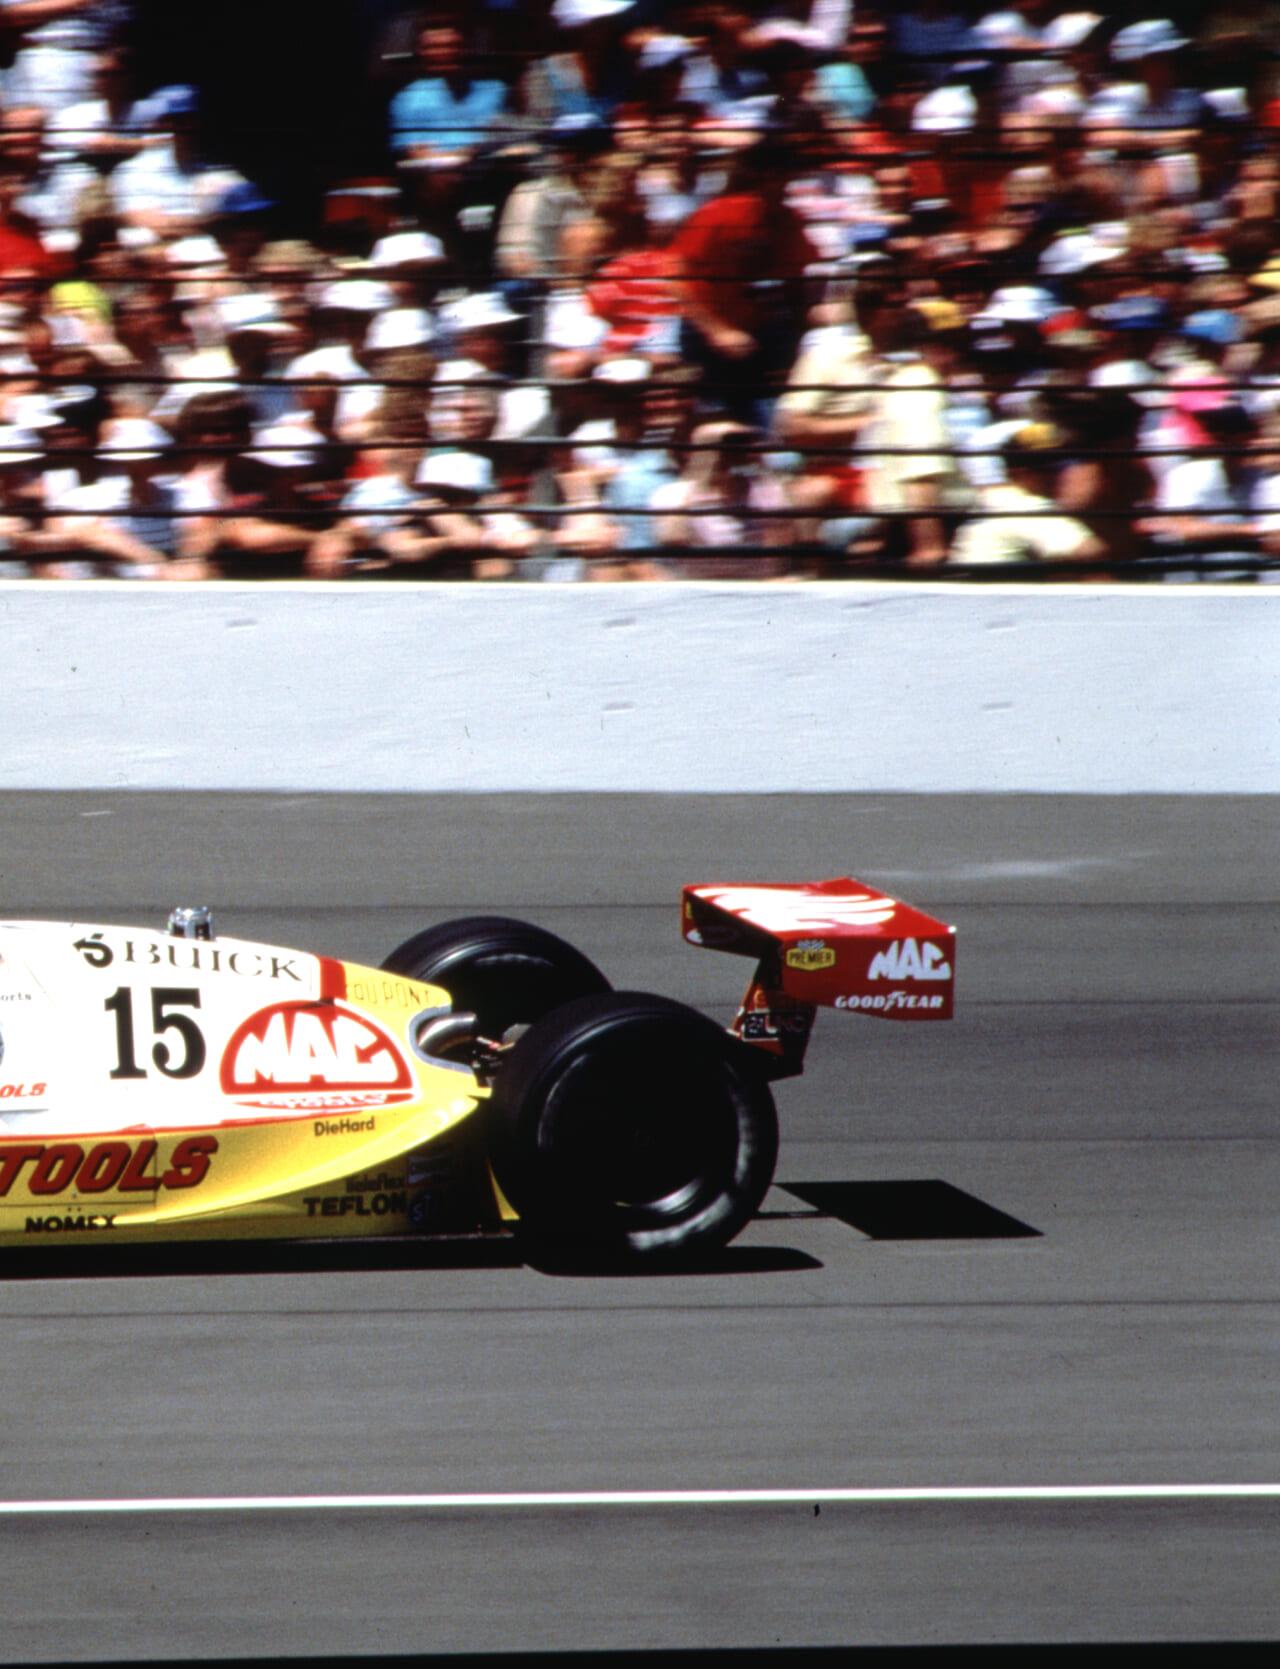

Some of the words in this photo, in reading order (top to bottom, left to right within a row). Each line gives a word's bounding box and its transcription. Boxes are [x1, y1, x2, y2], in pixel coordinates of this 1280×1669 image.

[123, 940, 303, 983] BUICK
[789, 951, 833, 964] PREMIER
[867, 937, 952, 980] MAC
[834, 990, 945, 1012] GOODYEAR
[104, 986, 207, 1081] 15
[233, 1009, 400, 1085] MAC
[314, 1115, 376, 1137] DieHard
[303, 1192, 407, 1217] TEFLON
[24, 1213, 118, 1234] NOMEX
